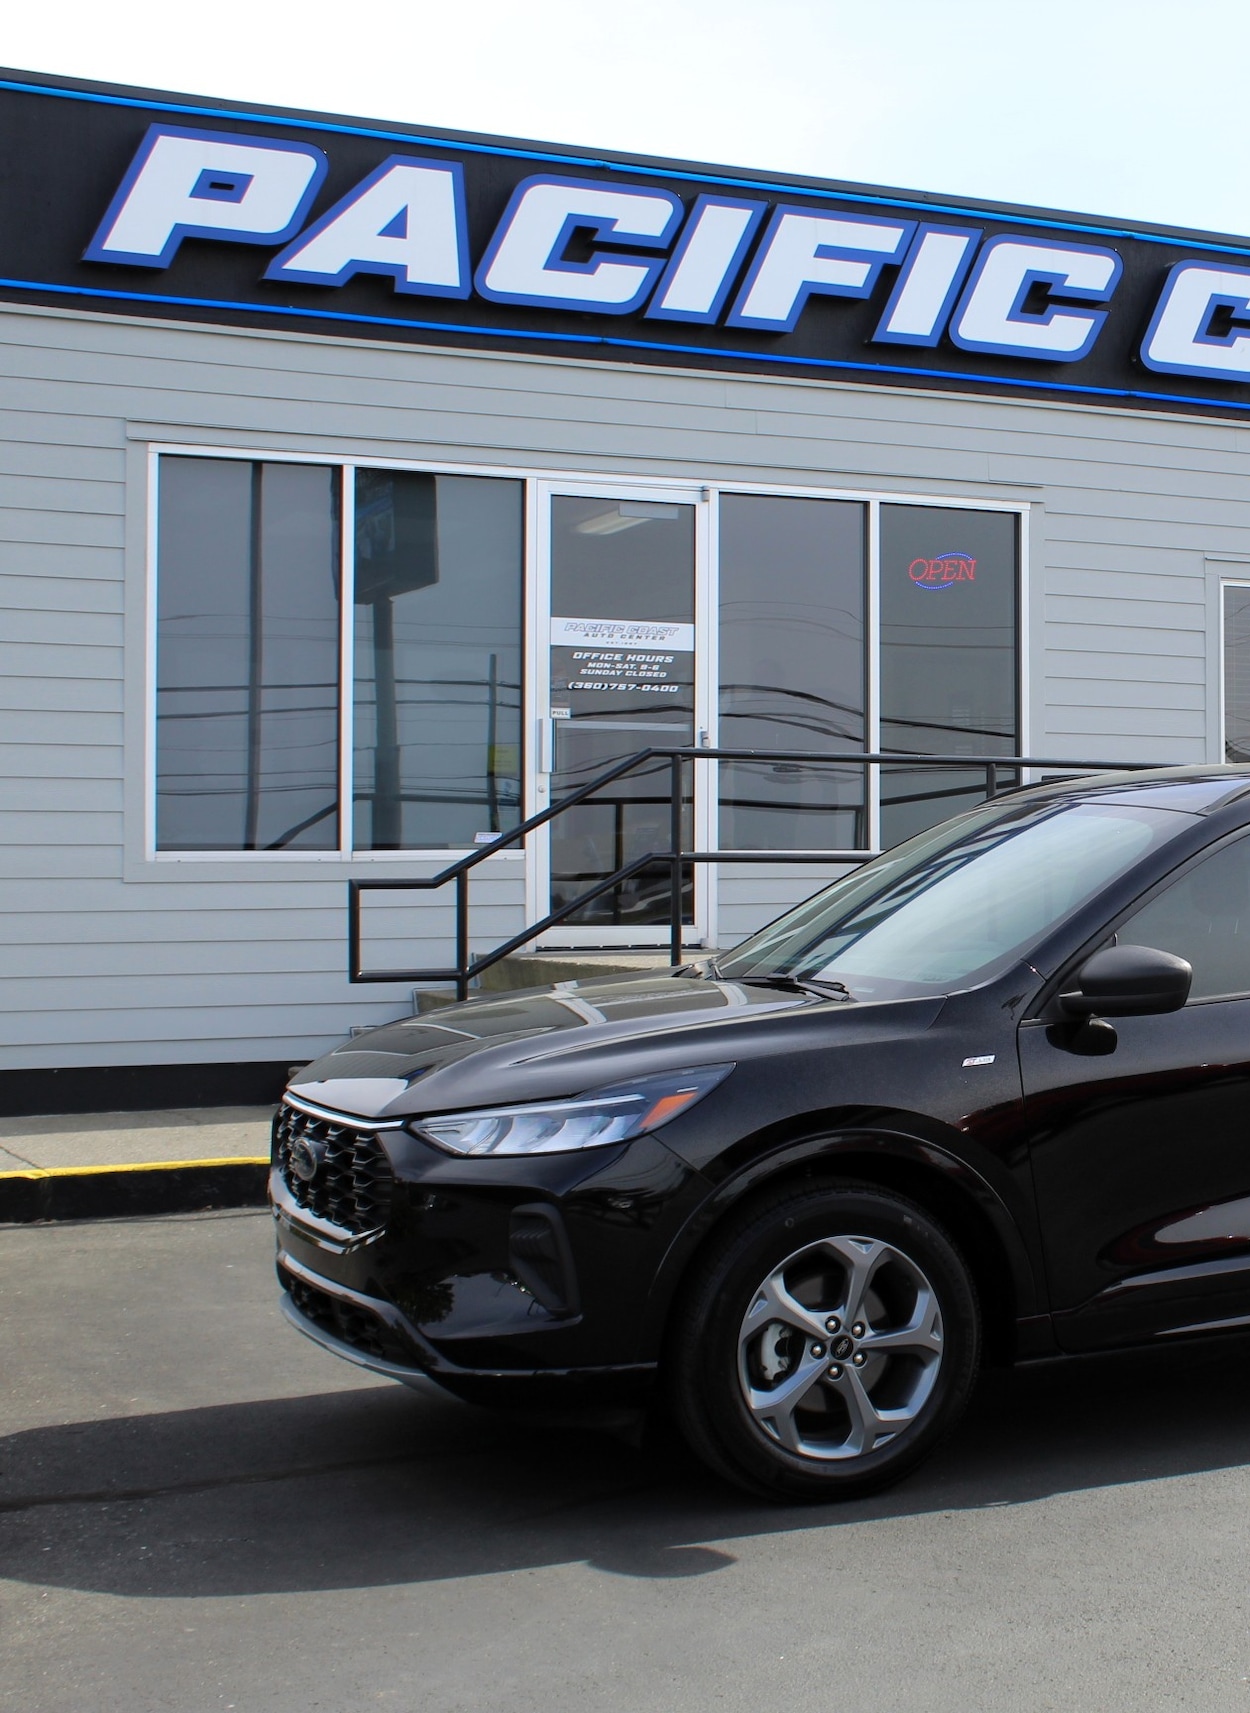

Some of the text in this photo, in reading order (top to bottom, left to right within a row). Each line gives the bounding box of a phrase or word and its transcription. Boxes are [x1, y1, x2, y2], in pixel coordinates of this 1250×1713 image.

[82, 122, 1124, 363] PACIFIC
[908, 558, 977, 581] OPEN
[564, 622, 680, 636] PACIFIC COAST
[572, 651, 675, 663] OFFICE HOURS
[587, 662, 637, 670] MON-SAT.
[580, 668, 667, 678] SUNDAY CLOSED
[567, 681, 680, 693] (360)757-0400
